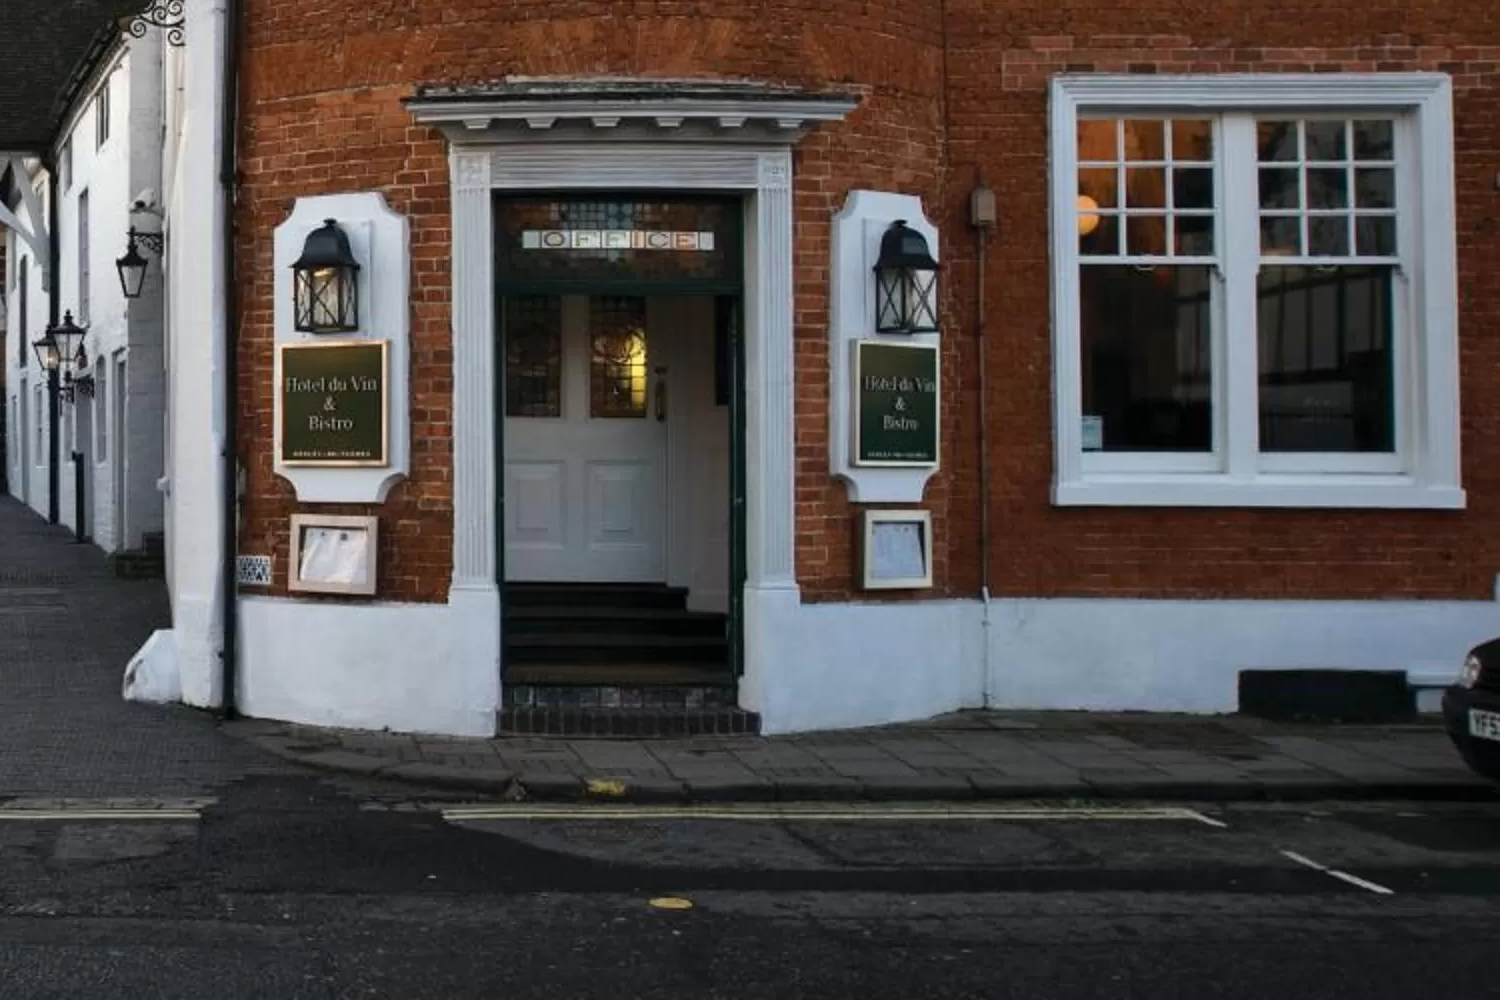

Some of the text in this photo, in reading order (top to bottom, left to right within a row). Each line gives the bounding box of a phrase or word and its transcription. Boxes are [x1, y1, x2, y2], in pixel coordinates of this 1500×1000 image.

[543, 231, 698, 250] OFFICE
[285, 375, 378, 393] Hotel du Vin
[865, 375, 897, 392] Hotel
[323, 395, 337, 411] &
[895, 396, 907, 411] &
[308, 415, 354, 432] Bistro
[883, 415, 920, 431] Bistro
